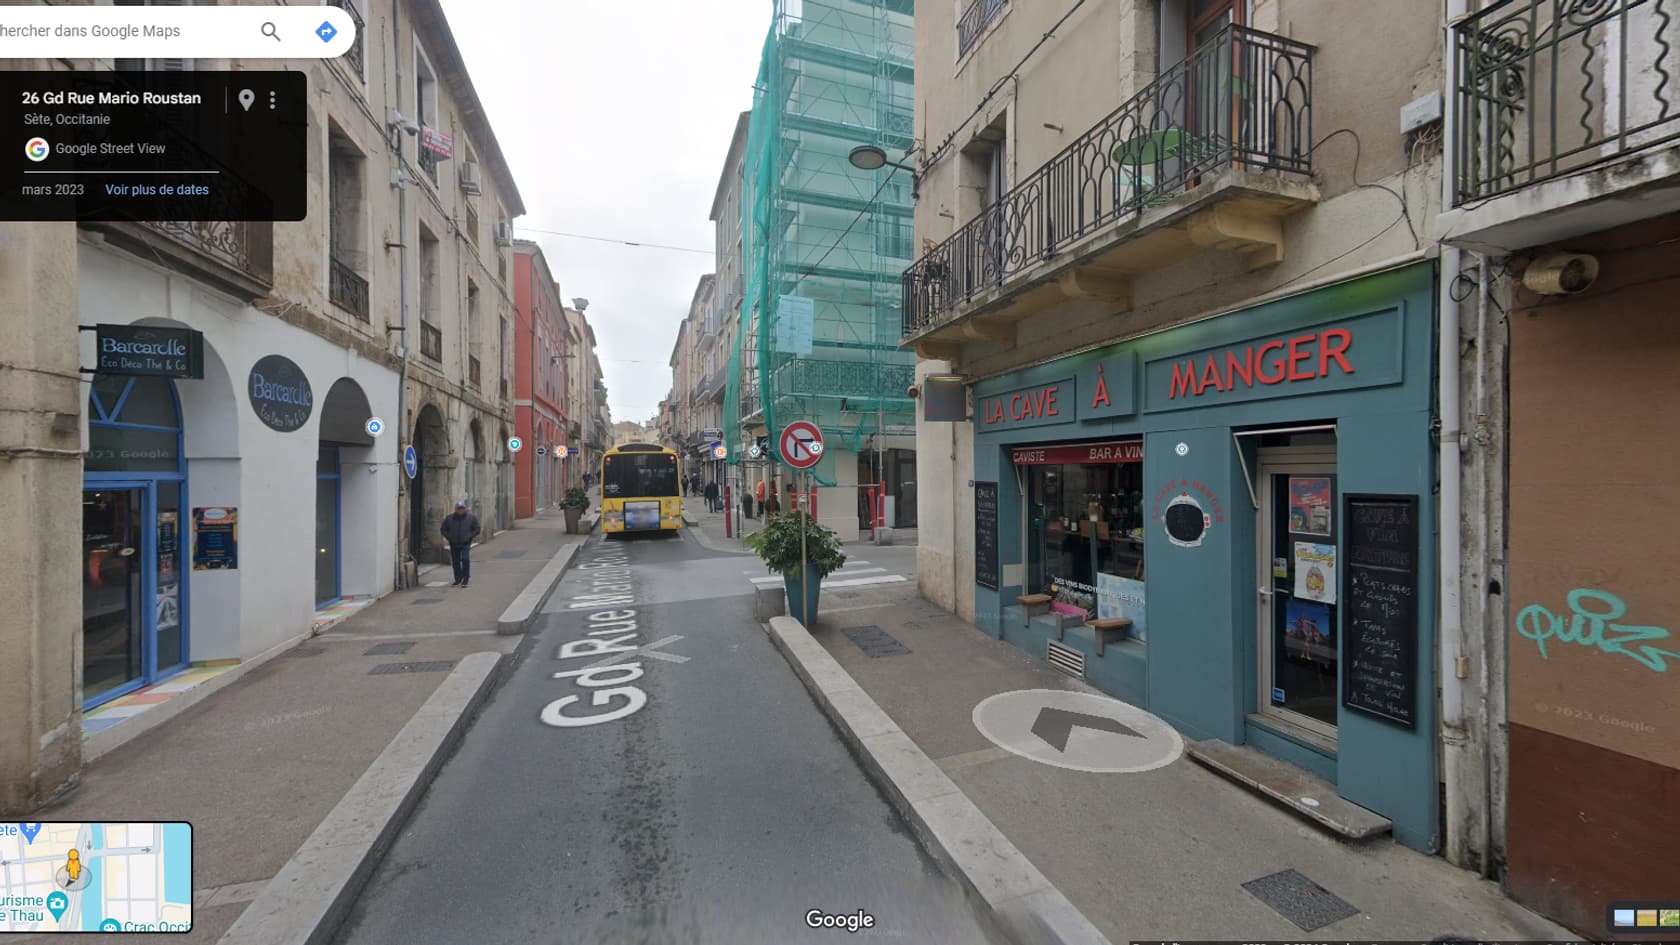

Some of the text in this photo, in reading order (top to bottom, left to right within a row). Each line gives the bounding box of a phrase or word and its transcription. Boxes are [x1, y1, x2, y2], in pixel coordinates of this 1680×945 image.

[985, 328, 1355, 424] LA CAVE À MANGER
[1013, 451, 1045, 462] CAVISTE
[1089, 447, 1112, 460] BAR
[1114, 447, 1123, 459] A
